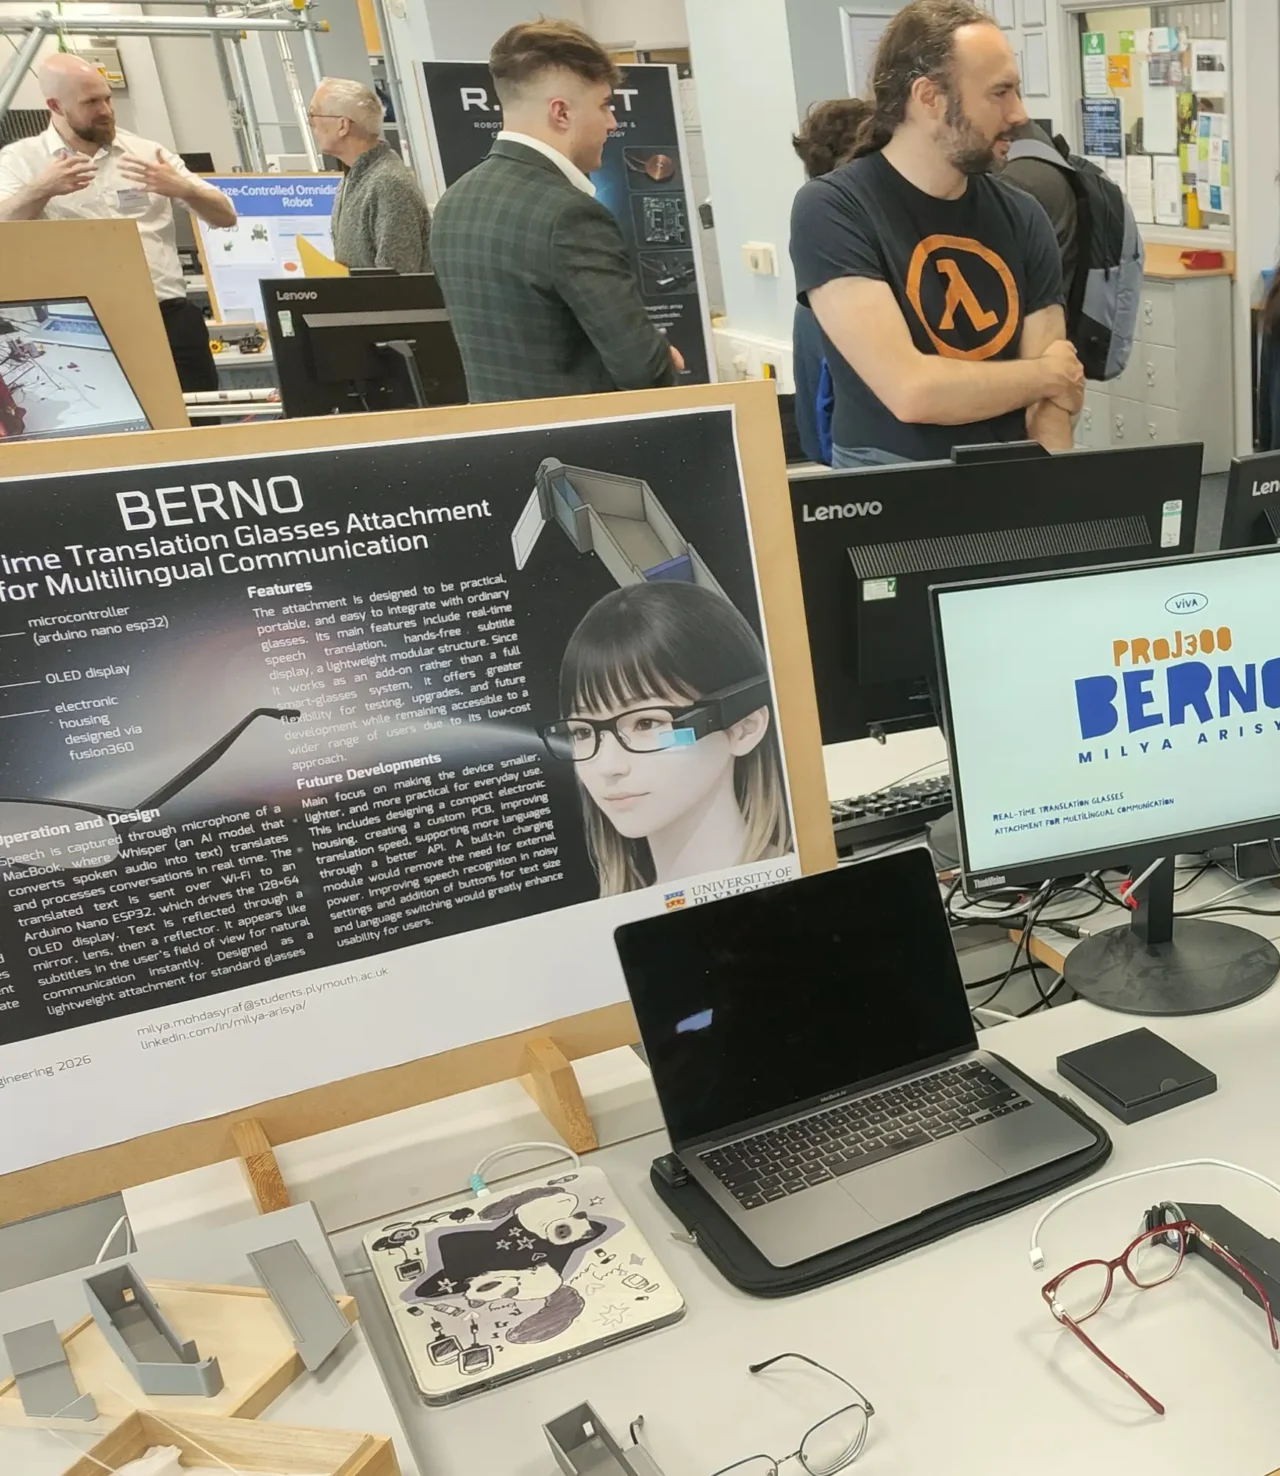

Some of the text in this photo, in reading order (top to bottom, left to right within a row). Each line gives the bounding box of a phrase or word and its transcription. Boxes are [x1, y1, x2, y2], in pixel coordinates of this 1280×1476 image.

[282, 197, 313, 208] Robot
[296, 185, 337, 196] Omnidir
[276, 291, 317, 301] Lenovo
[115, 475, 303, 531] BERNO
[803, 500, 883, 523] Lenovo
[70, 533, 229, 566] Translation
[233, 520, 339, 546] Glasses
[346, 499, 491, 533] Attachment
[0, 534, 428, 602] for Multilingual Communication
[247, 581, 312, 598] Features
[252, 573, 507, 618] The attachment is designed to be practical,
[27, 606, 129, 627] microcontroller
[256, 589, 509, 636] portable, and easy to integrate with ordinary
[33, 615, 169, 646] (arduino nano esp32)
[269, 633, 517, 680] display, a lightweight modular structure. Since
[1113, 626, 1232, 667] PROJ300
[45, 664, 130, 684] OLED display
[54, 695, 118, 713] electronic
[58, 714, 110, 729] housing
[64, 725, 142, 744] designed via
[69, 741, 134, 760] fusion360
[1078, 739, 1173, 764] MILYA
[296, 753, 441, 789] Future Developments
[301, 753, 540, 808] Main focus on making the device smaller,
[304, 767, 543, 823] lighter, and more practical for everyday use.
[993, 792, 1124, 822] REAL-TIME TRANSLATION GLASSES
[74, 815, 103, 831] and
[106, 808, 160, 825] Design
[311, 793, 549, 850] housing, creating a custom PCB, improving
[994, 798, 1175, 835] ATTACHMENT FOR MULTILINGUAL COMMUNICATION
[2, 819, 285, 881] MacBook, where Whisper (an AI model that
[692, 871, 772, 896] UNIVERSITY
[776, 866, 792, 878] OF
[24, 925, 72, 942] Arduino
[75, 917, 108, 930] Nano
[111, 906, 155, 923] ESP32,
[158, 898, 194, 913] which
[197, 891, 233, 905] drives
[235, 886, 254, 896] the
[37, 916, 310, 986] subtitles in the user's field of view for natural
[56, 1054, 92, 1073] 2026
